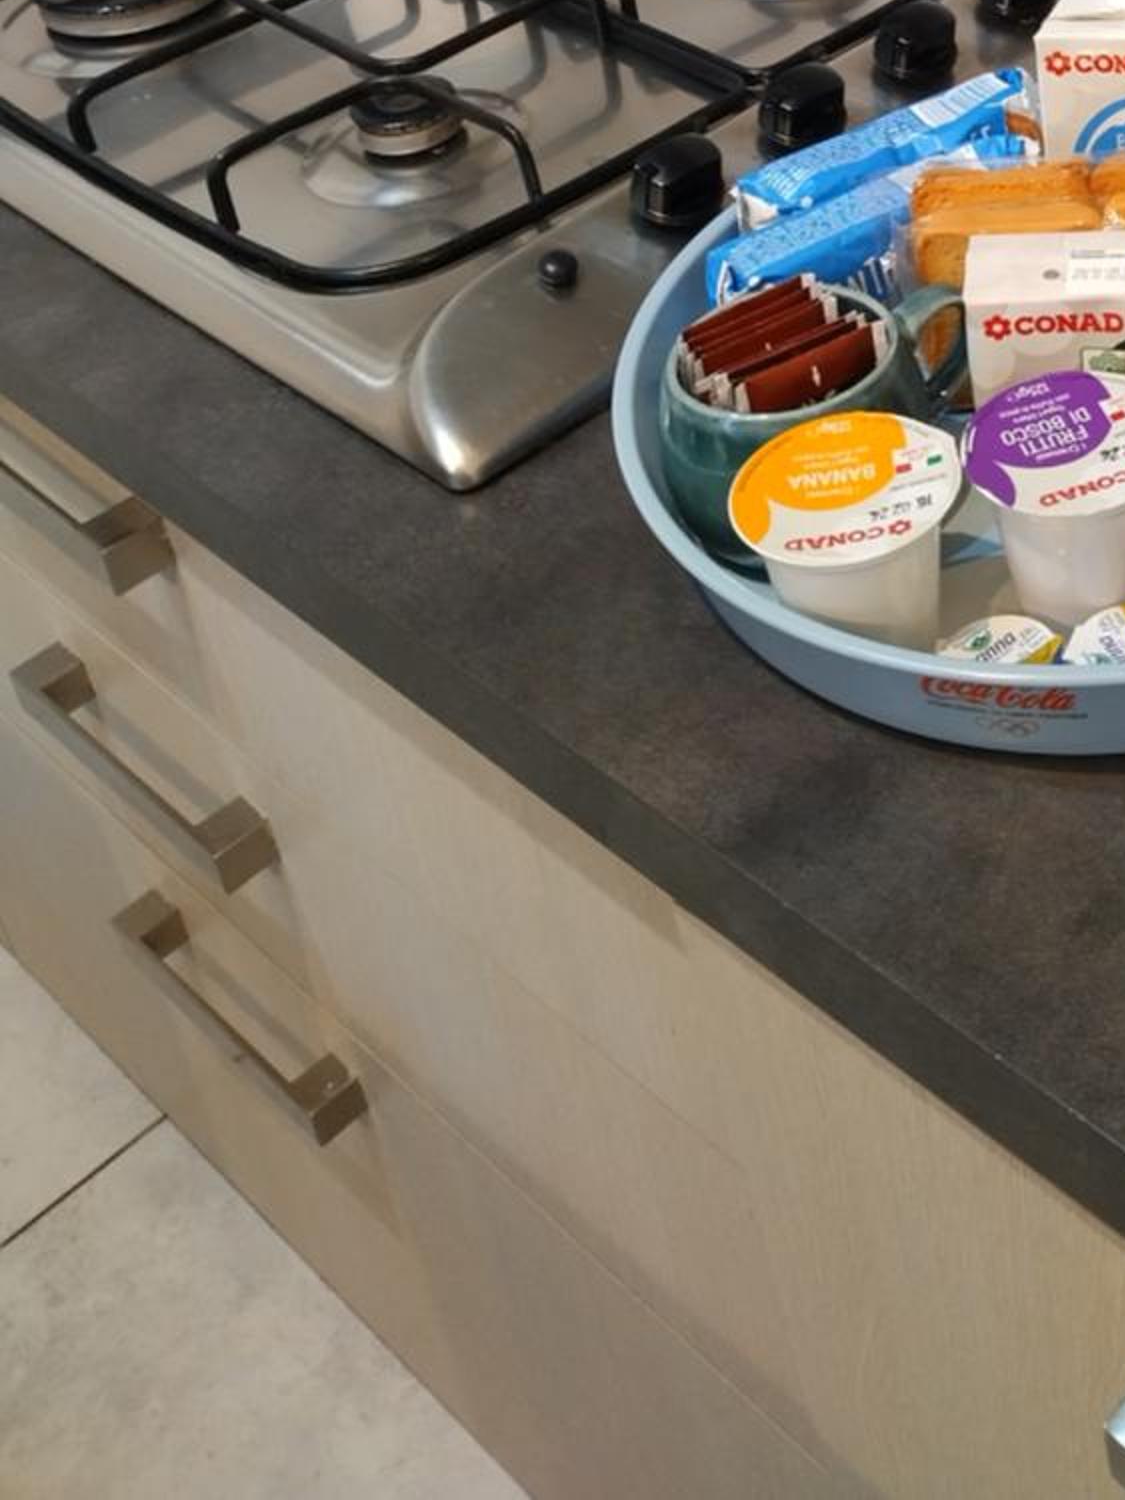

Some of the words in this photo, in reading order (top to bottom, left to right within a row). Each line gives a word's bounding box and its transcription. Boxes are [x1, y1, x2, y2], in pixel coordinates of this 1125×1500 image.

[1014, 312, 1125, 336] CONAD
[1068, 406, 1091, 423] DI
[1000, 414, 1067, 447] BOSCO
[1019, 424, 1089, 457] FRUTTI
[787, 462, 877, 490] BANANA
[783, 525, 885, 552] CONAD
